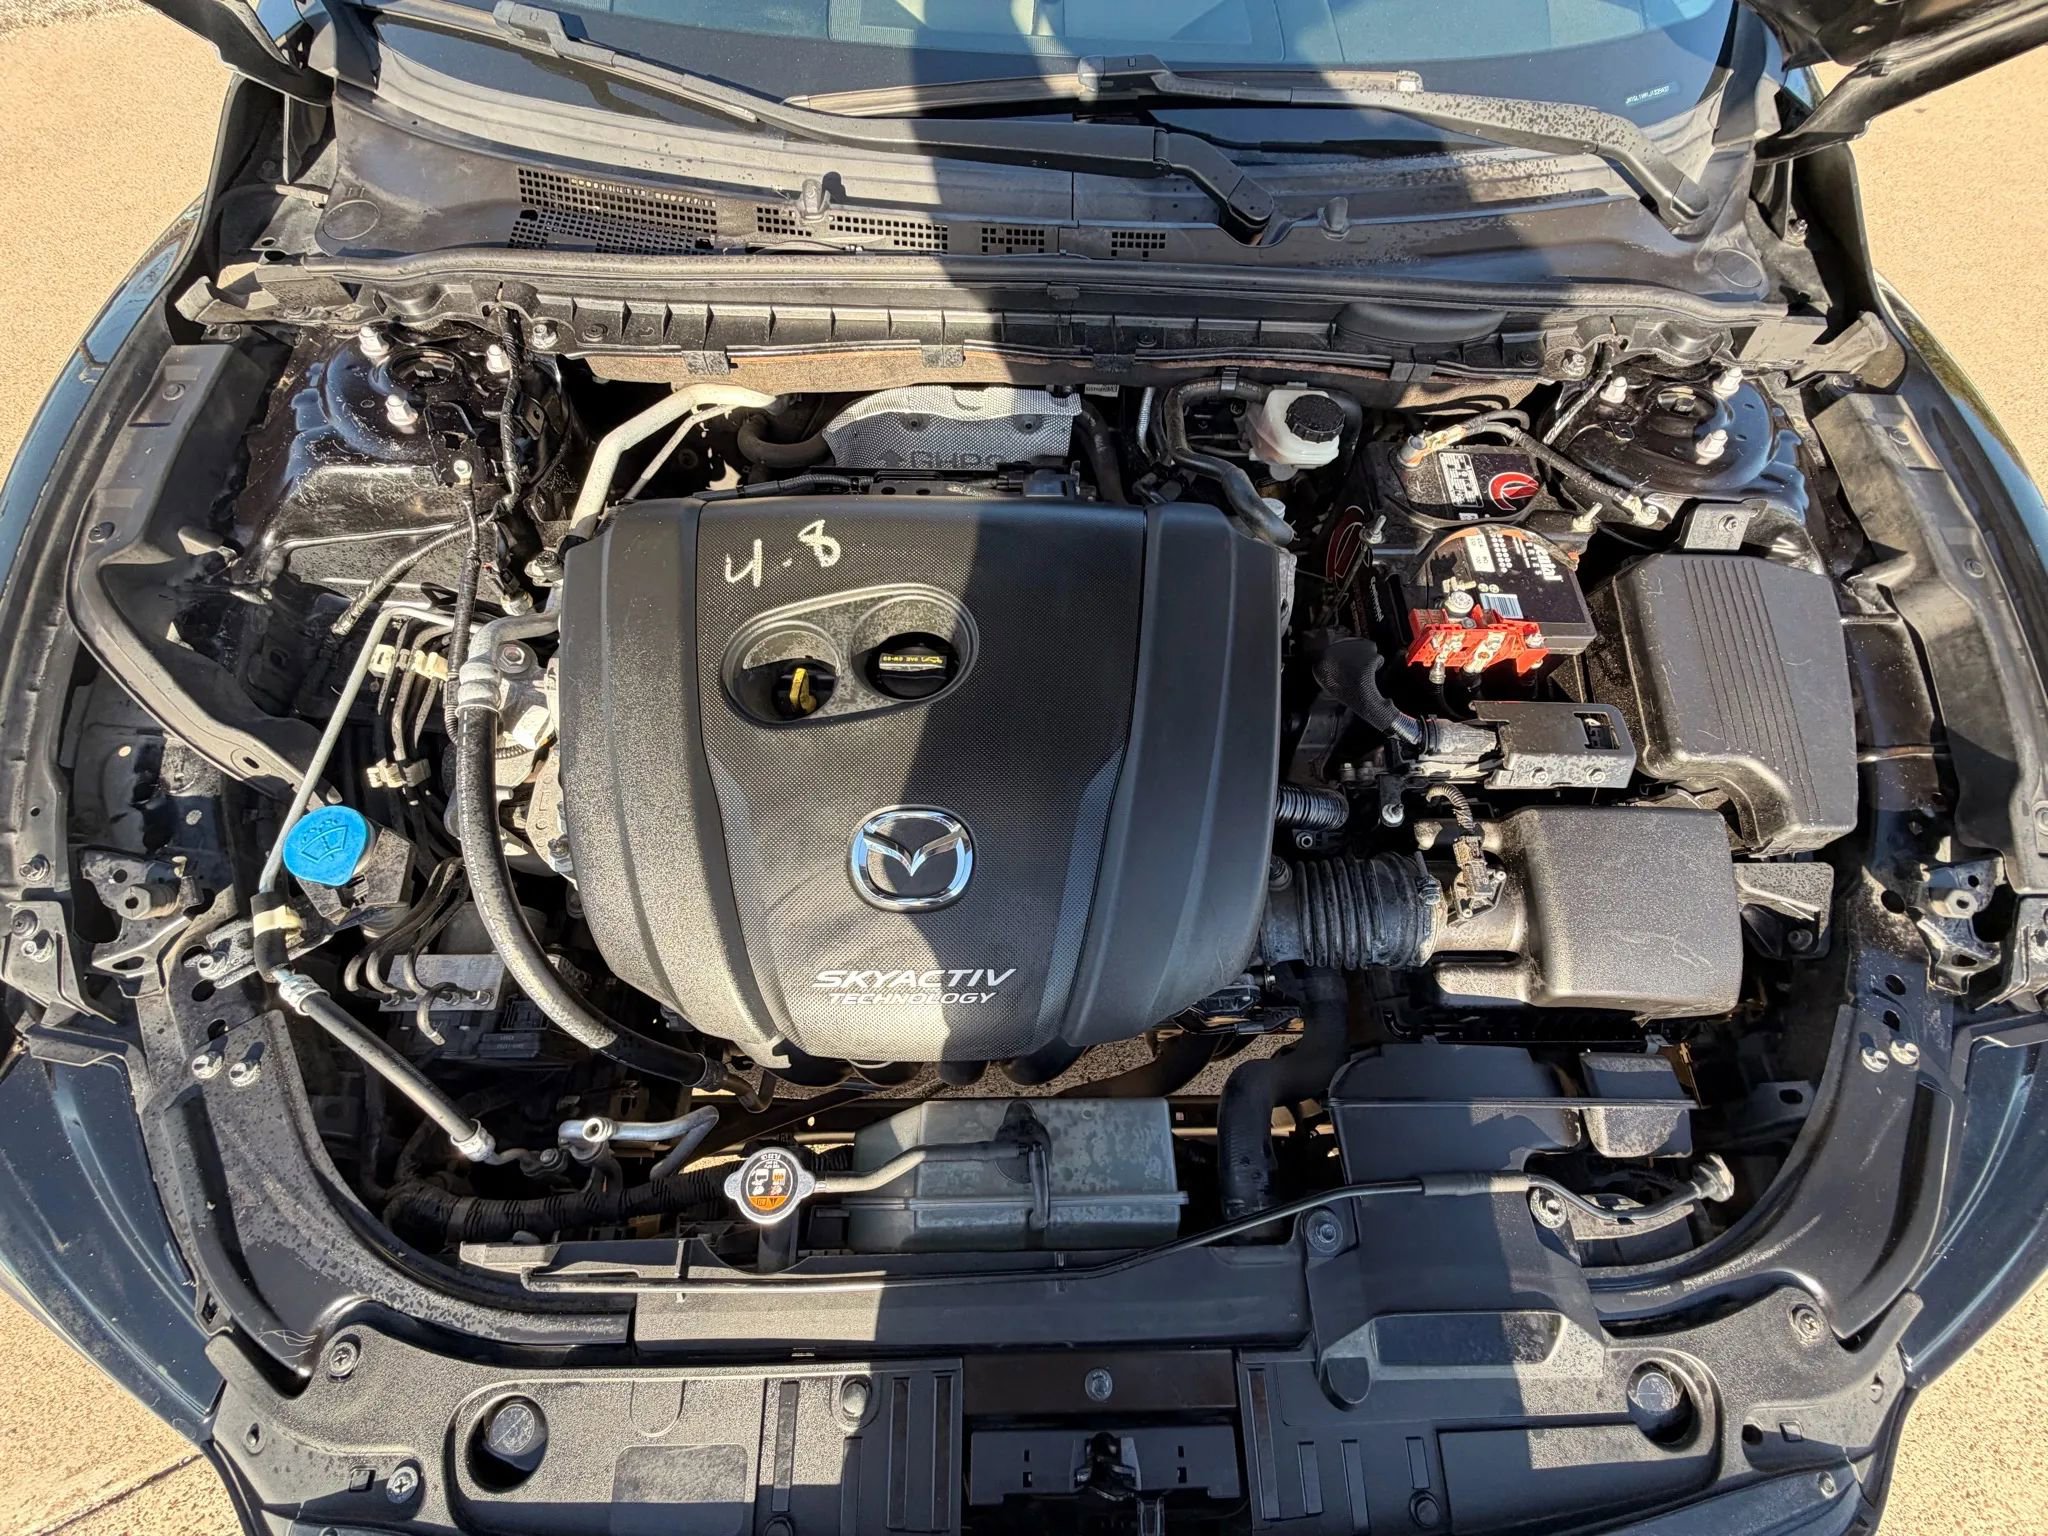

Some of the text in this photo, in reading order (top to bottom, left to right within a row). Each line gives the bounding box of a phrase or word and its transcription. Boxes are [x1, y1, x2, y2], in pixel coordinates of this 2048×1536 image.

[1525, 542, 1542, 575] ERIES
[466, 850, 481, 887] GALAXY
[811, 968, 1017, 988] SKYACTIV
[827, 992, 997, 1006] TECHNOLOGY
